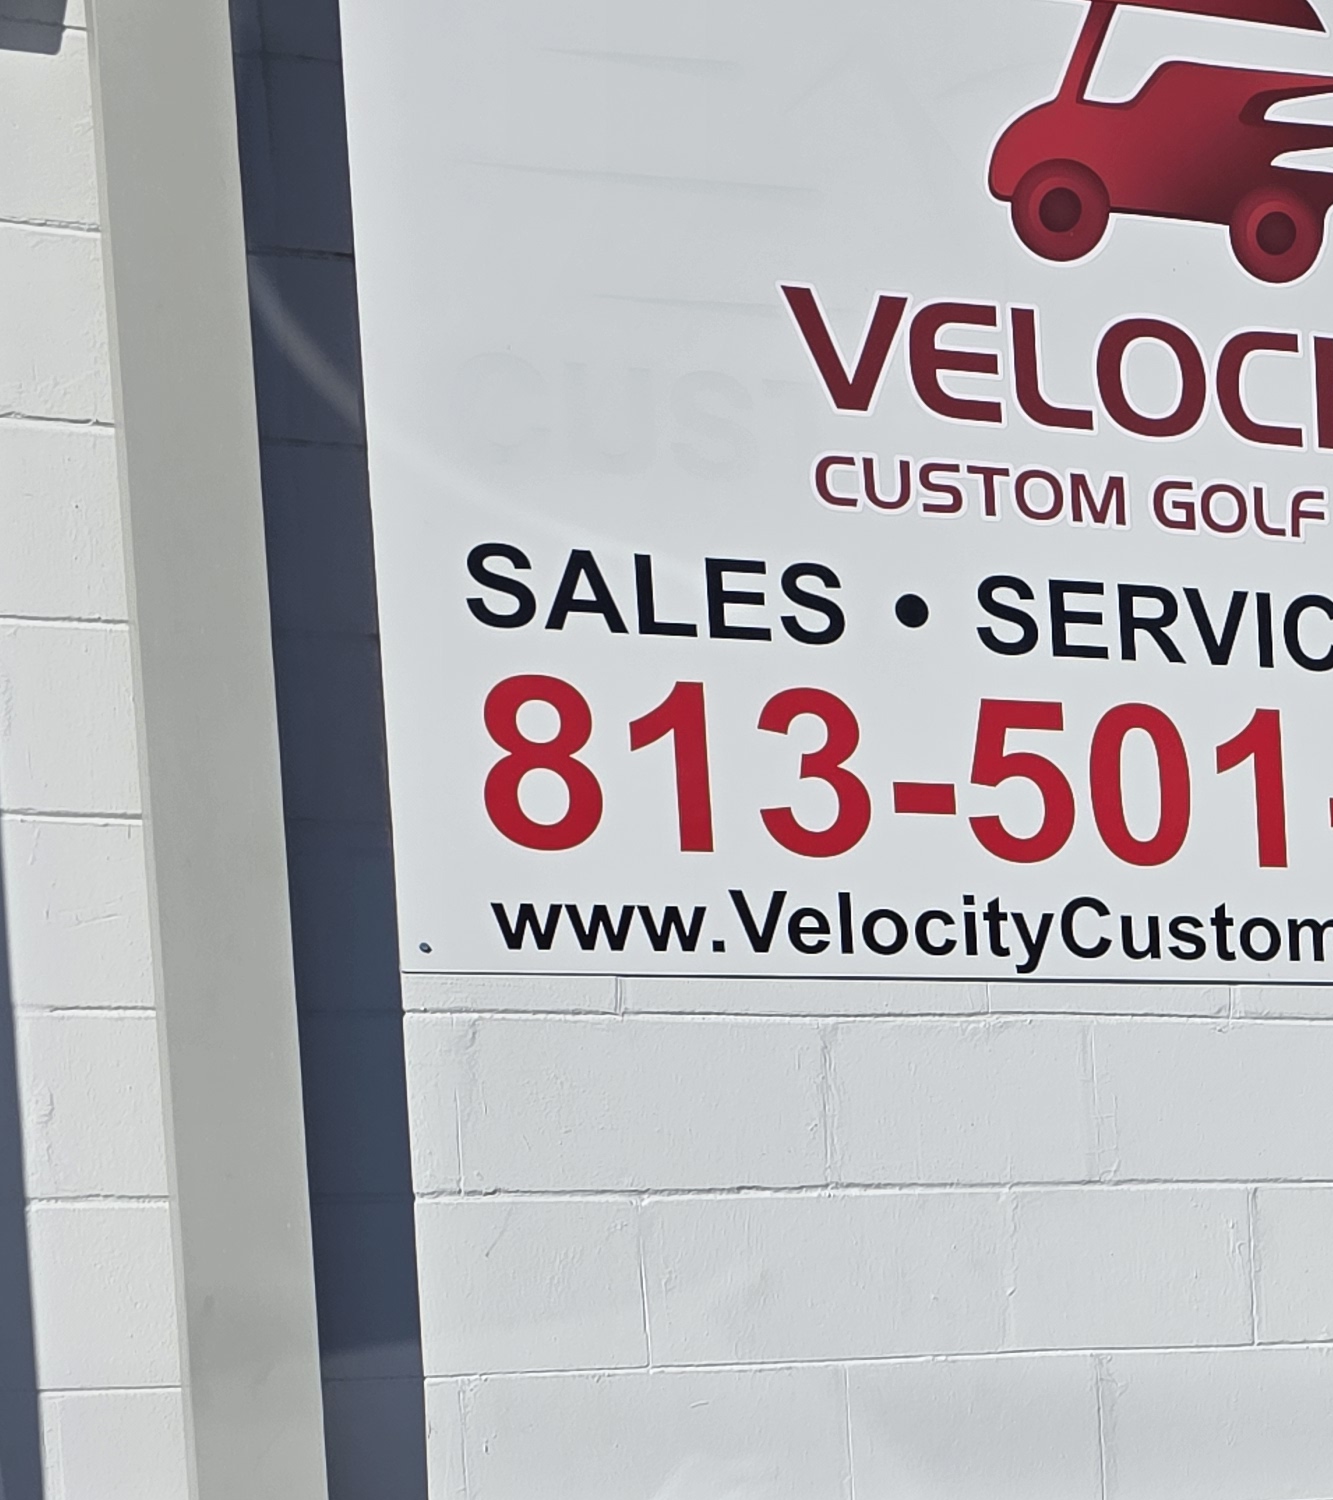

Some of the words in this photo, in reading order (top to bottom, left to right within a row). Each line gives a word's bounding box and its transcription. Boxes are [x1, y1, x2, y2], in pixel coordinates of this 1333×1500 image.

[814, 454, 1127, 527] CUSTOM
[1152, 479, 1326, 539] GOLF
[465, 541, 847, 646] SALES
